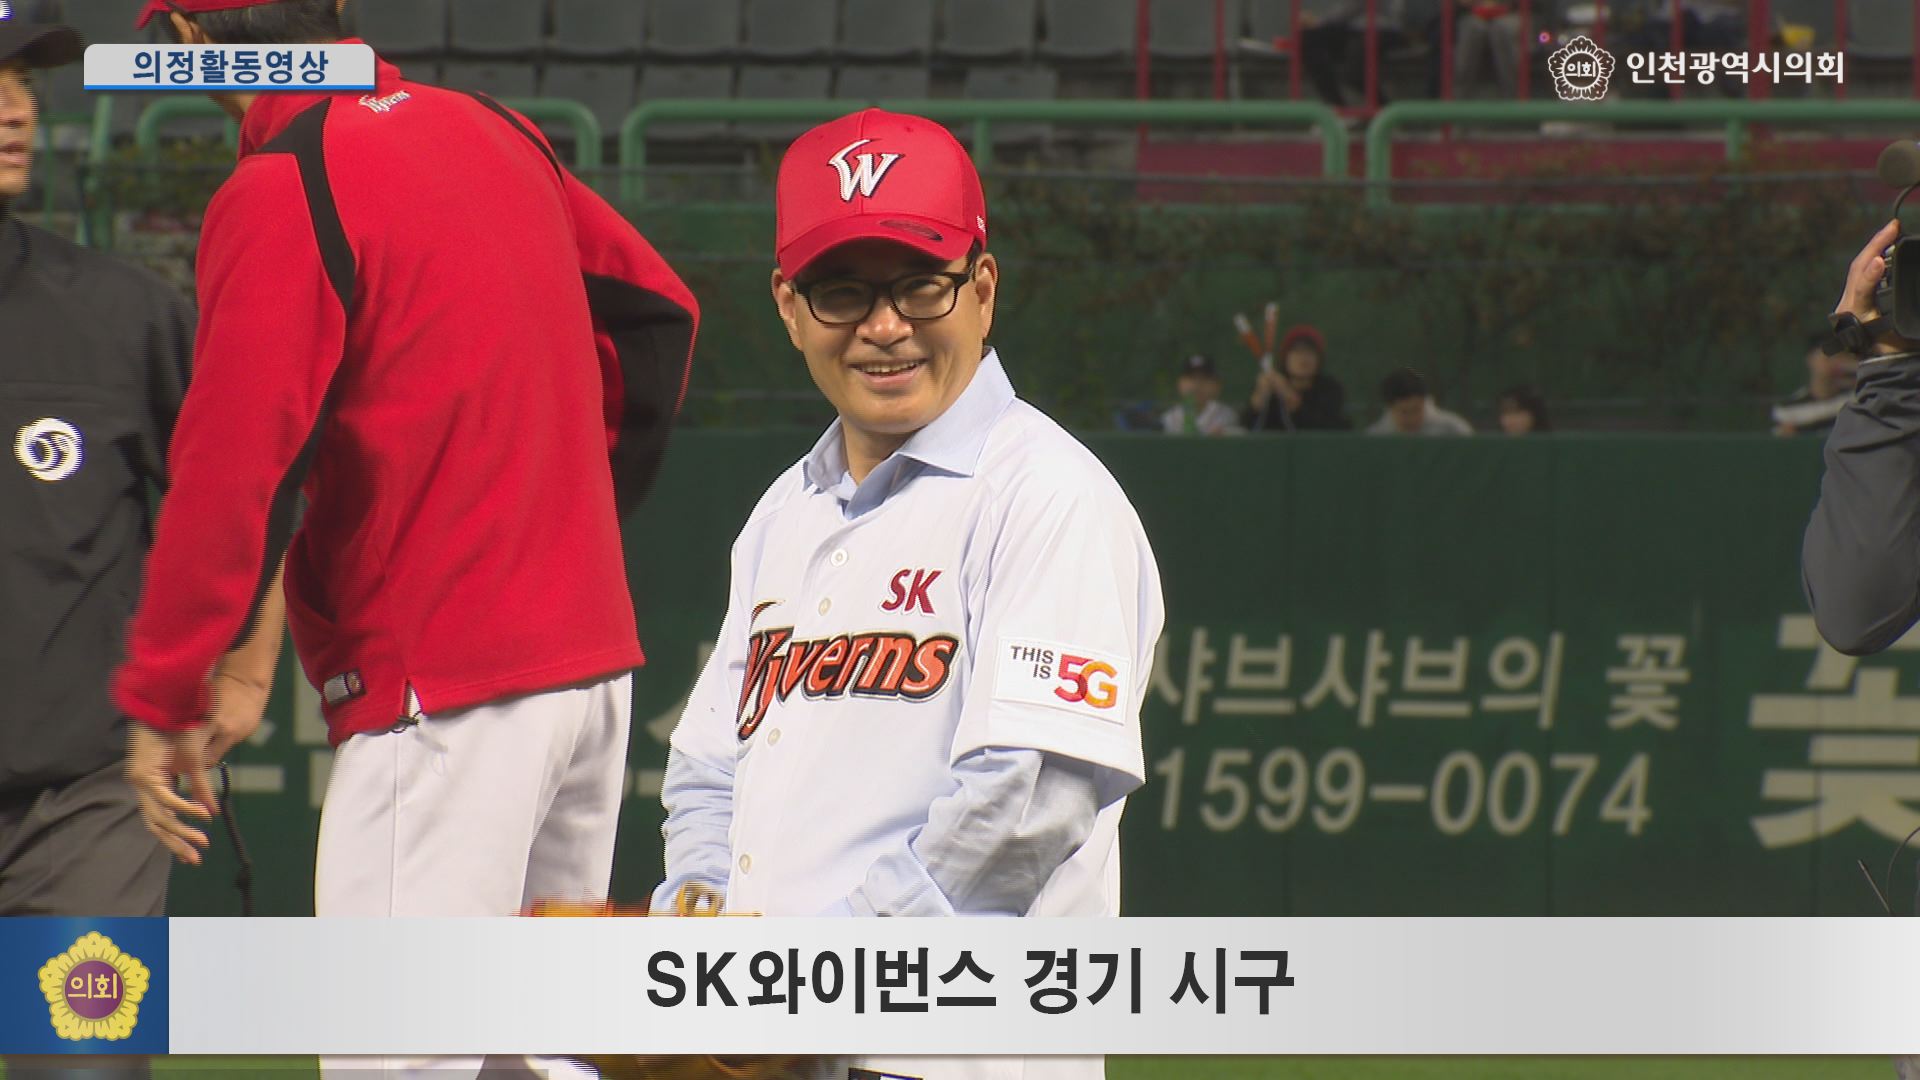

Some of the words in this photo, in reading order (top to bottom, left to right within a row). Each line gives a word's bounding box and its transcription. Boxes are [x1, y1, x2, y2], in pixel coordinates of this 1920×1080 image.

[880, 567, 941, 614] SK
[1010, 645, 1054, 666] THIS
[1032, 664, 1051, 681] IS
[1150, 626, 1564, 730] 샤브샤브의
[1605, 634, 1691, 730] 꽃
[1053, 654, 1118, 710] 5G
[1153, 746, 1653, 836] 1599-0074
